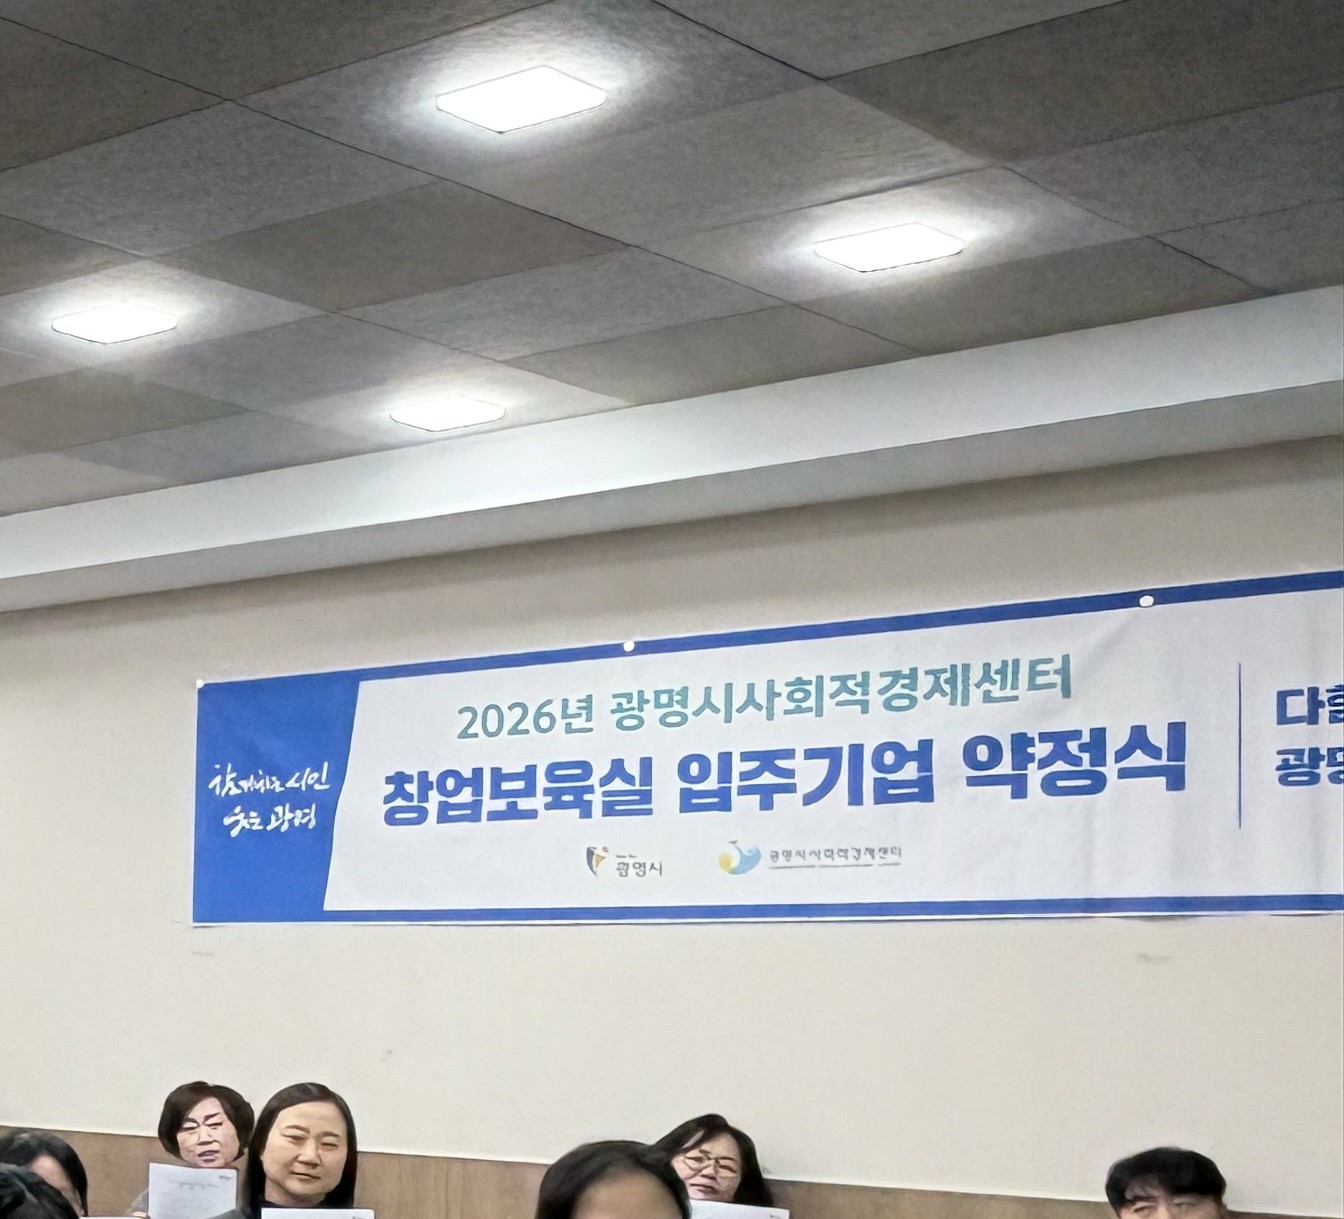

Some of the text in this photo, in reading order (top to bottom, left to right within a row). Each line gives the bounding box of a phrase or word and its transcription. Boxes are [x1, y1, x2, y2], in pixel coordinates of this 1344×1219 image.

[456, 653, 1072, 740] 2026년 광명시사회적경제센터
[382, 720, 1188, 827] 창업보육실 입주기업 약정식
